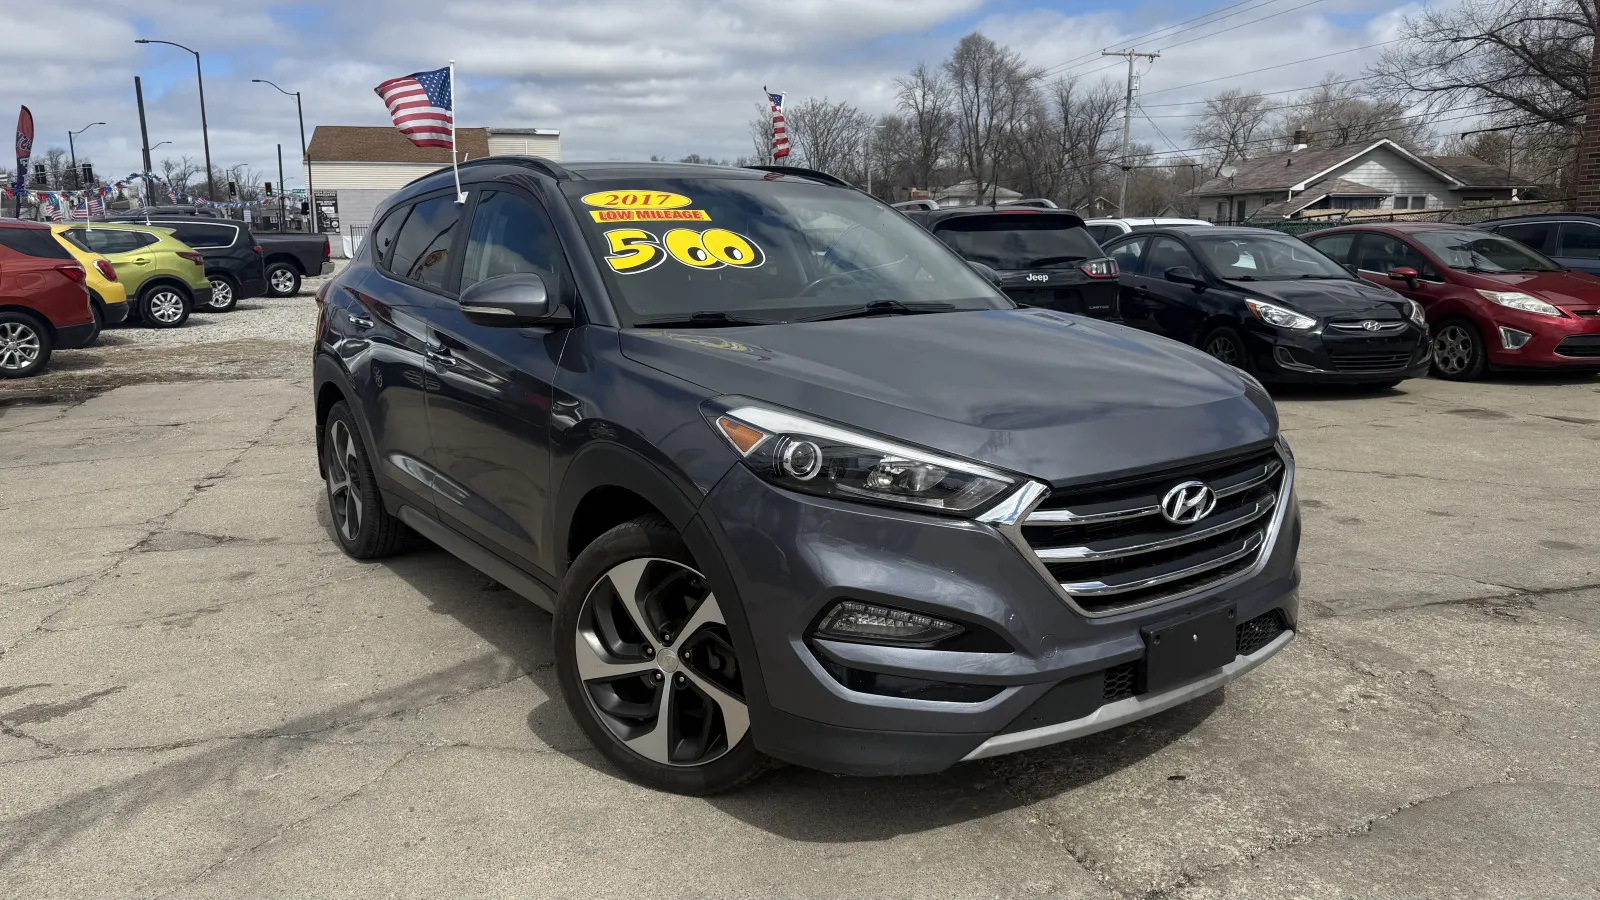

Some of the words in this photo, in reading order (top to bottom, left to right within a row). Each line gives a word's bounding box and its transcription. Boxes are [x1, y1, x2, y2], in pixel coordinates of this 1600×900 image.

[604, 194, 671, 206] 2017
[598, 211, 633, 221] LOW
[636, 210, 703, 220] MILEAGE
[1026, 273, 1048, 282] Jeep
